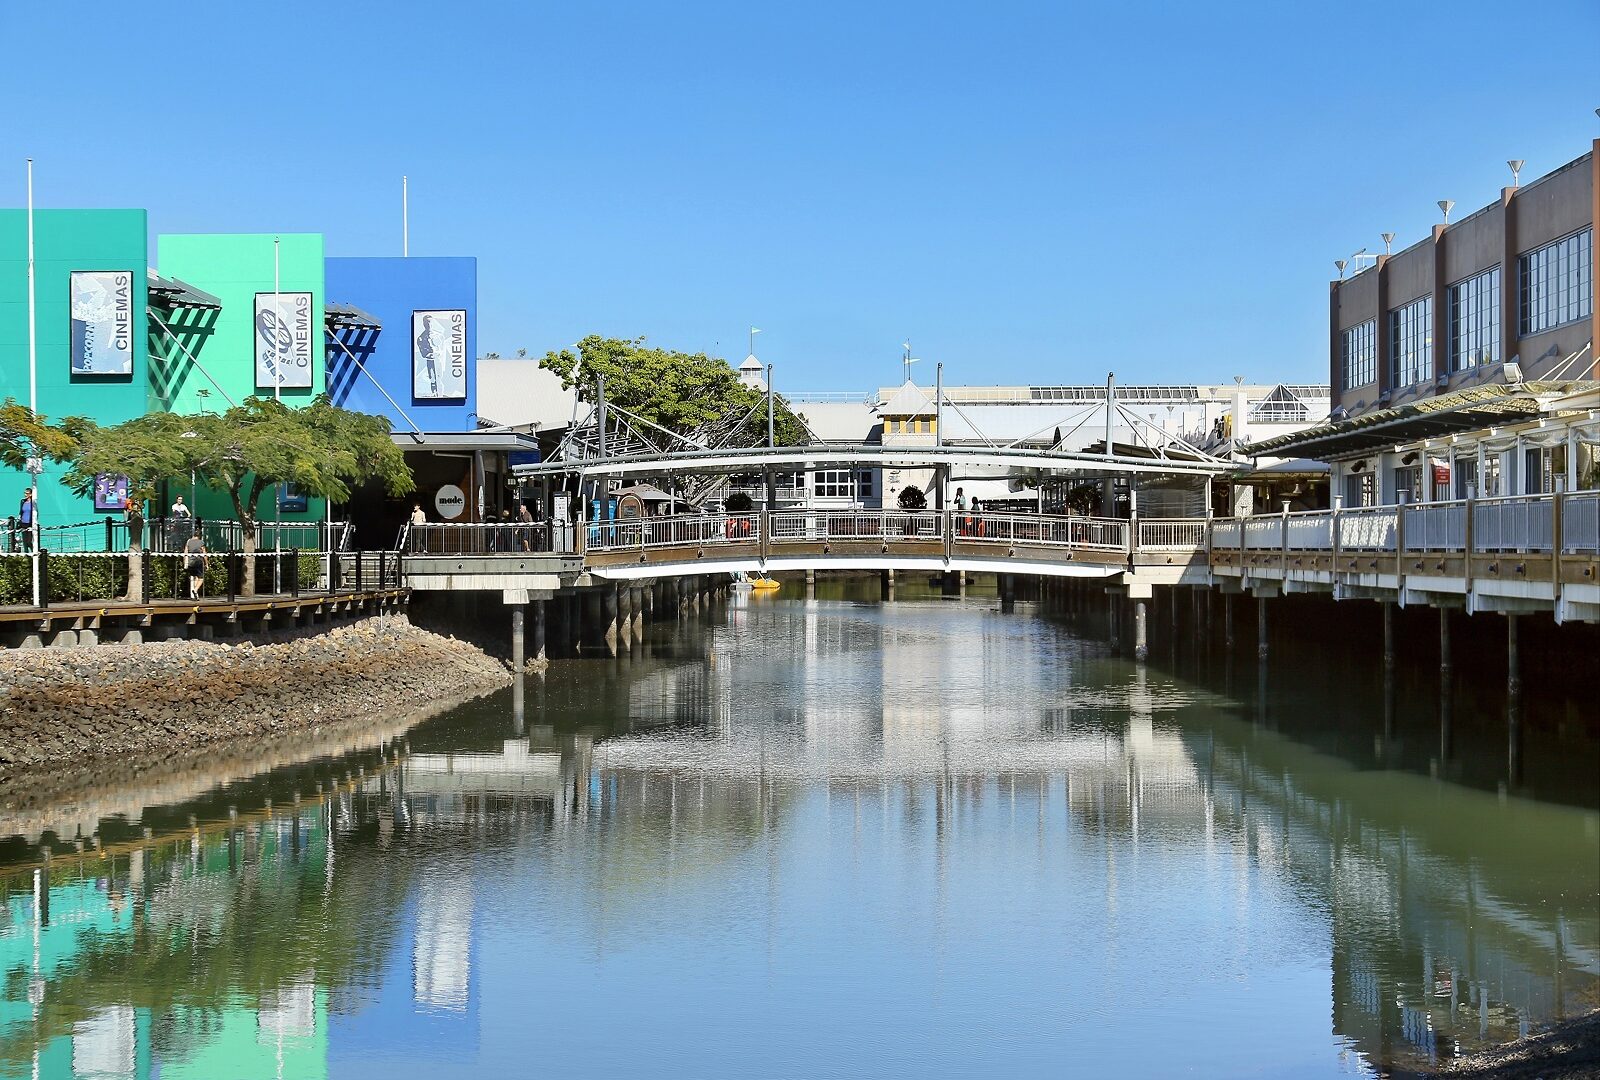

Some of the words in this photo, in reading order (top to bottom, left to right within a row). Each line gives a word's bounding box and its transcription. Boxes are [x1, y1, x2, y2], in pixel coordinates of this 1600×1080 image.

[83, 321, 95, 371] POPCORN
[115, 275, 128, 351] CINEMAS
[296, 296, 308, 368] CINEMAS
[452, 313, 463, 378] CINEMAS
